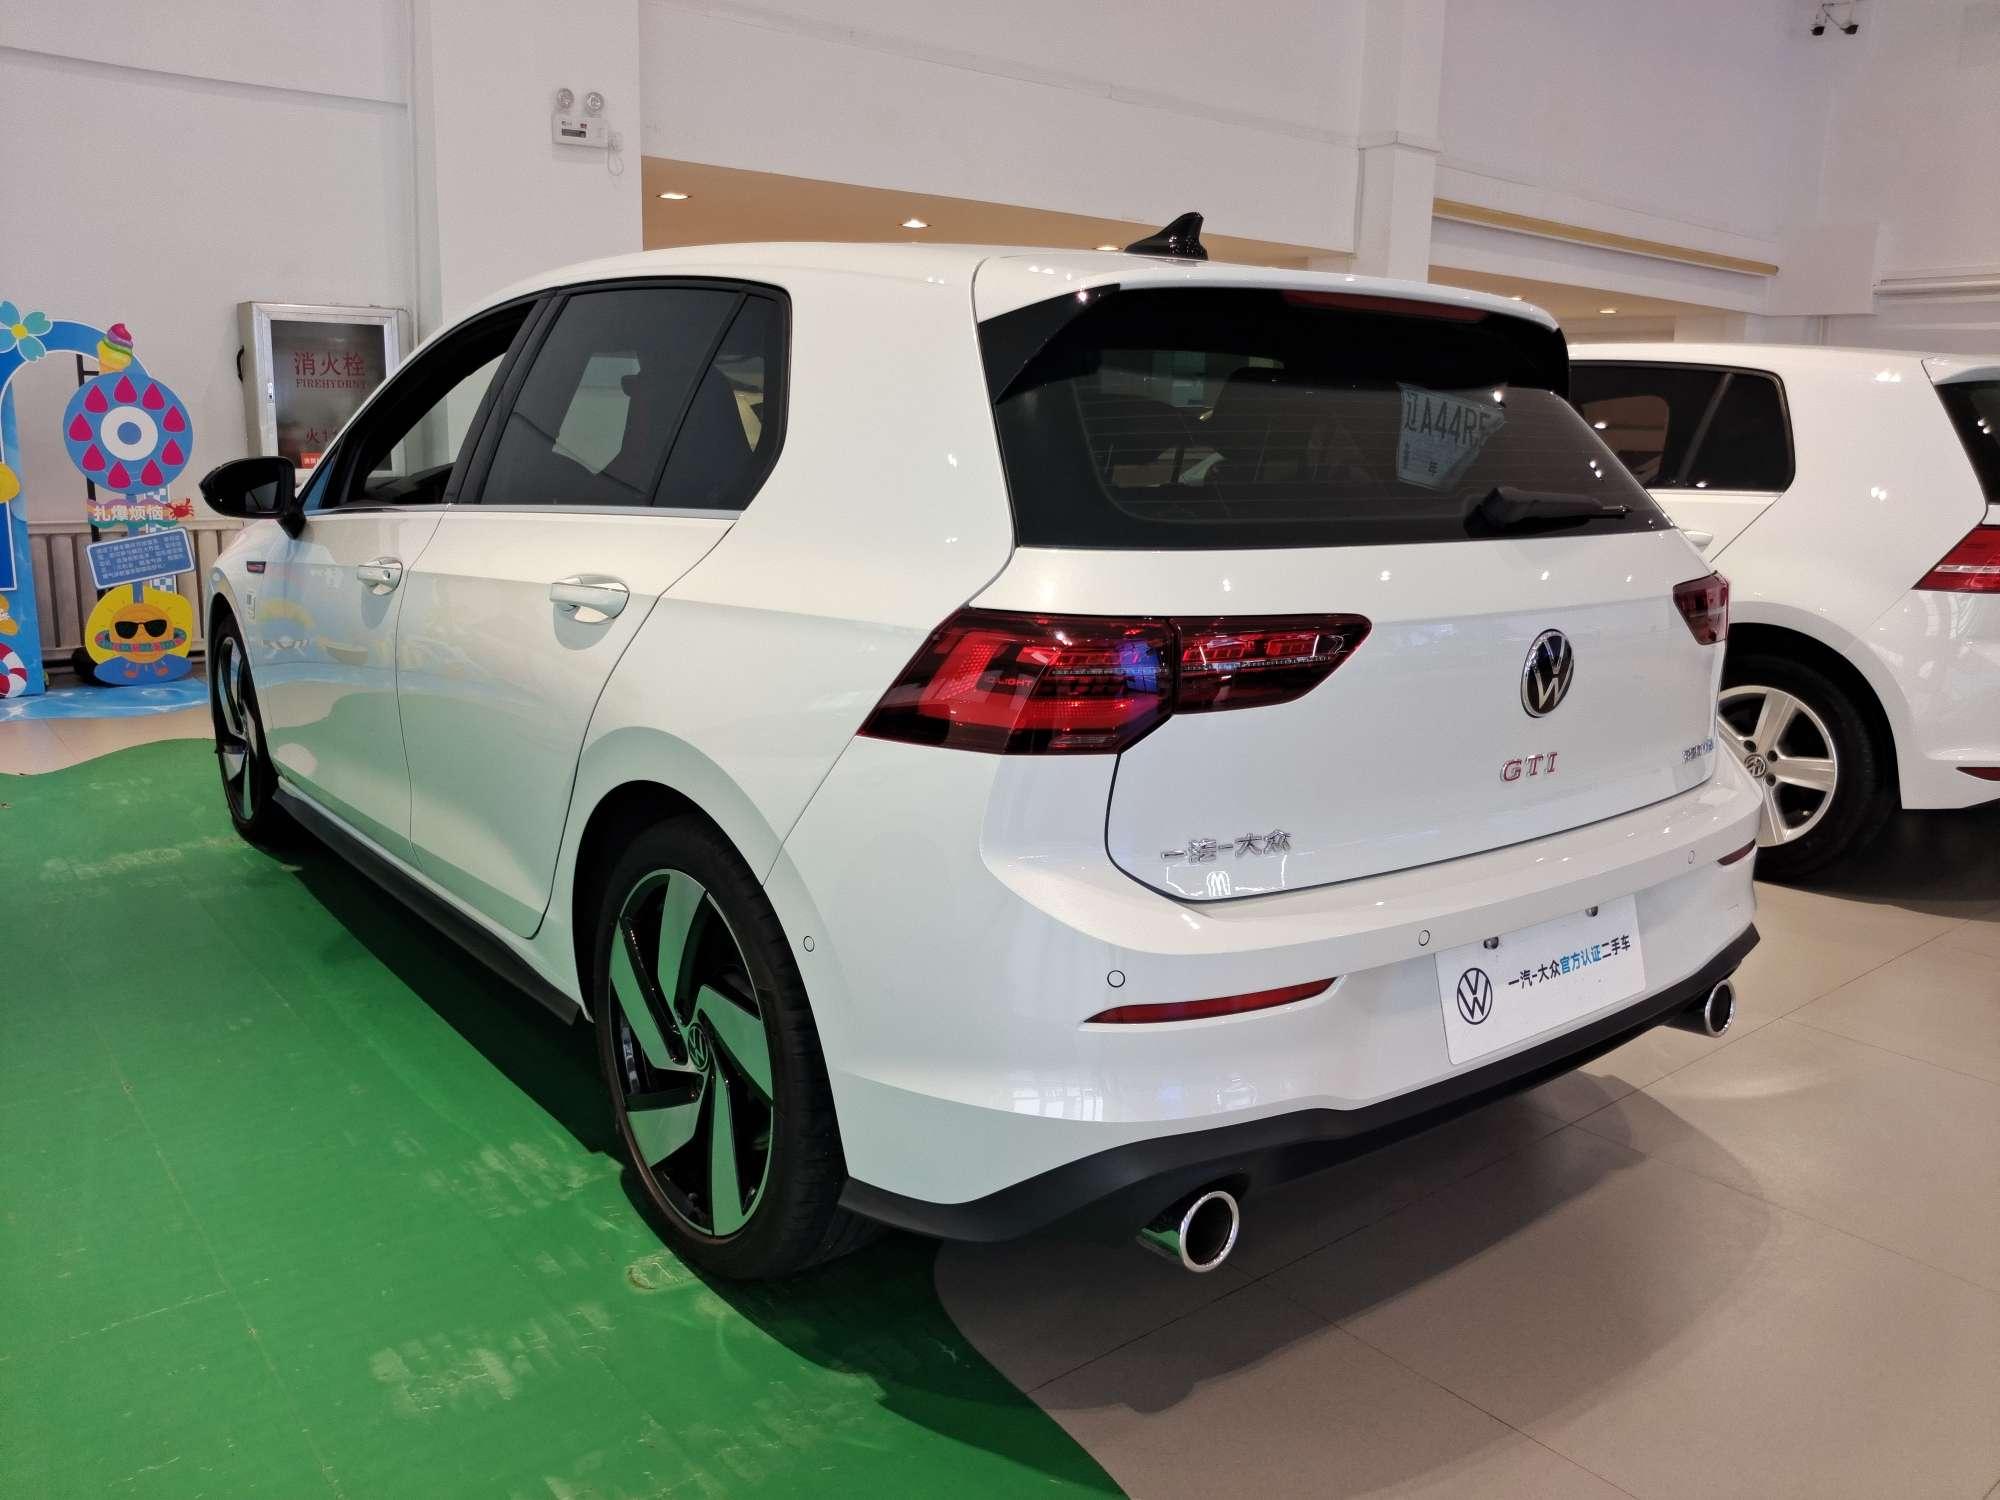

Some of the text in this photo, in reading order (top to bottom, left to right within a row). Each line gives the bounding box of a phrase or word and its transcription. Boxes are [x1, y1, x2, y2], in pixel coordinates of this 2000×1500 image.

[294, 352, 366, 376] 消火栓
[95, 504, 164, 521] 扎爆烦恼
[1501, 752, 1557, 781] GTI
[1161, 829, 1291, 863] 一汽-大众
[1508, 934, 1631, 989] 一汽-大众官方认证二手车
